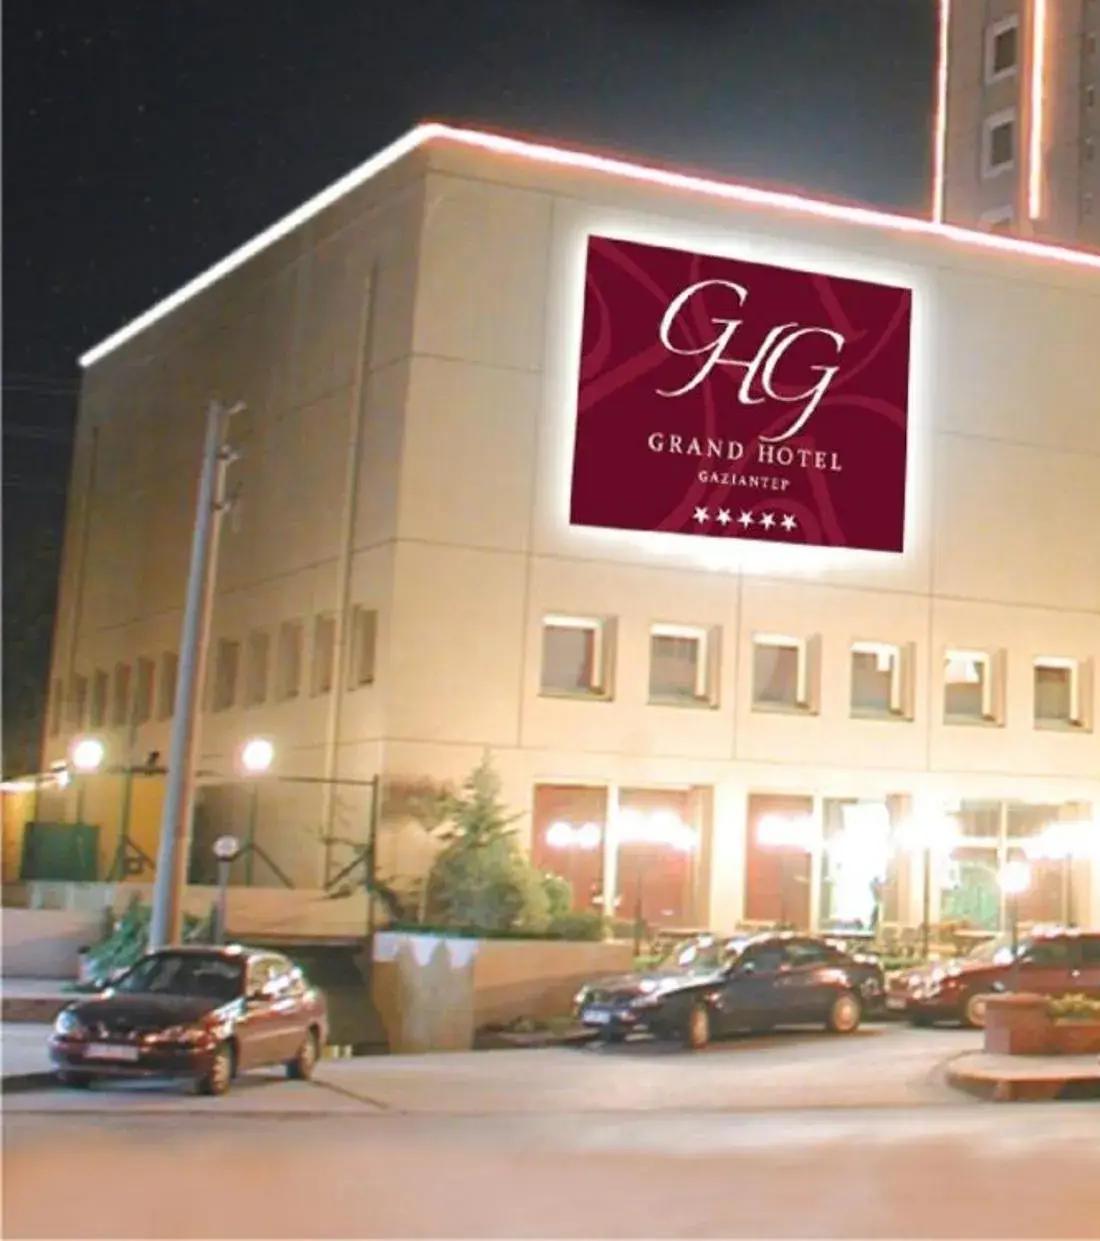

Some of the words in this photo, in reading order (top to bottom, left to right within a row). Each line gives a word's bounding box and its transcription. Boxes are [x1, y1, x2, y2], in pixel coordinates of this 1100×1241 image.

[656, 279, 845, 442] GHG
[648, 432, 744, 460] GRAND
[758, 443, 843, 471] HOTEL
[698, 470, 791, 491] GAZIANTEP
